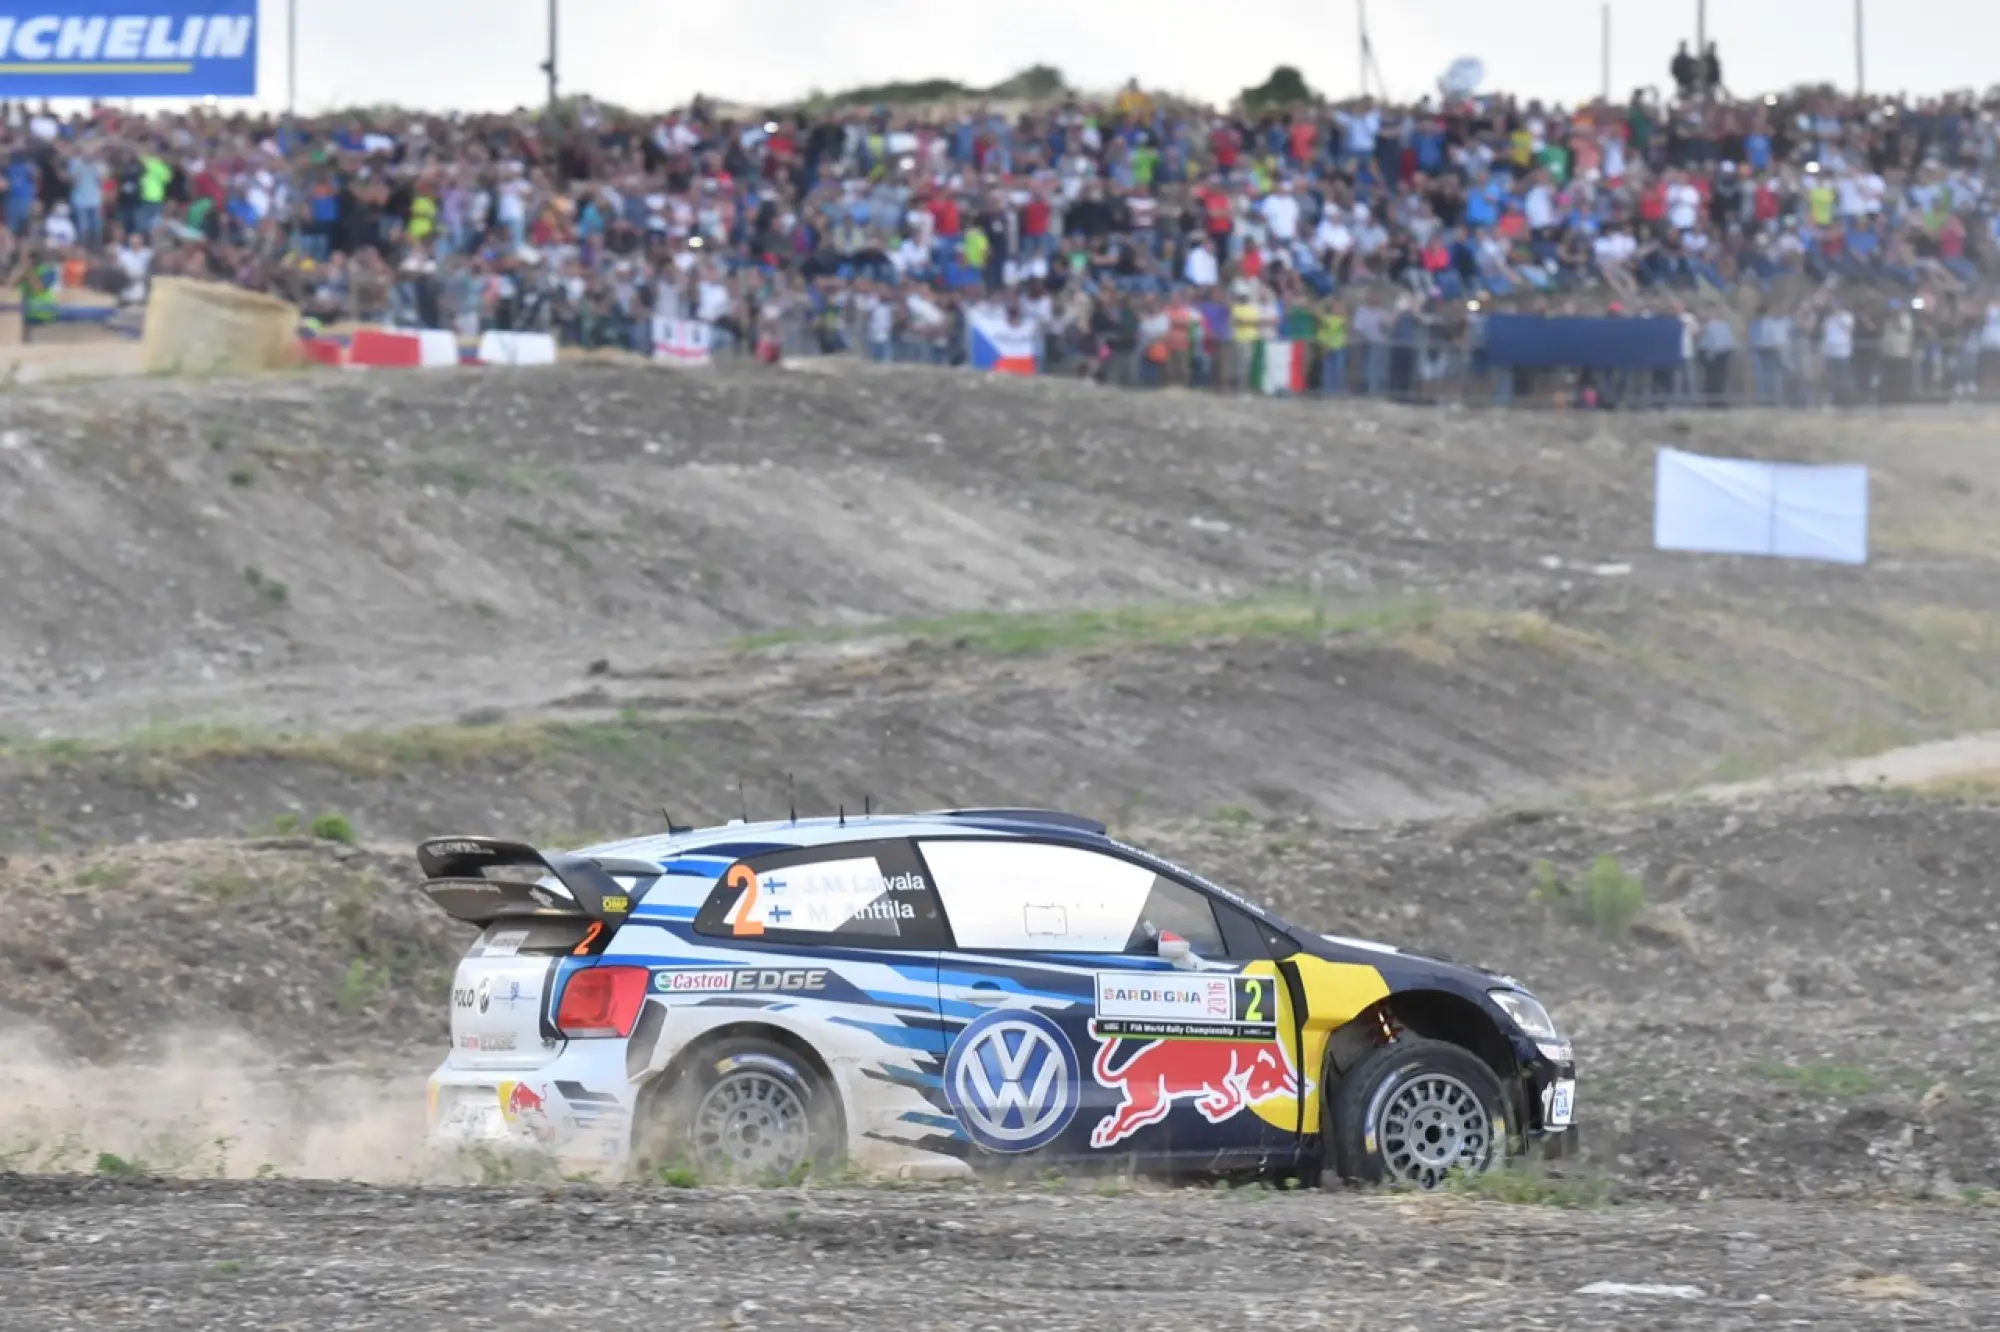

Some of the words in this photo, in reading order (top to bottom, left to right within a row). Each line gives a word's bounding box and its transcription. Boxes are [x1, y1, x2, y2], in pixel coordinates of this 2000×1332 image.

[603, 898, 628, 910] OMP
[727, 864, 765, 935] 2
[844, 900, 915, 921] Anttila
[572, 920, 605, 955] 2
[673, 973, 730, 989] Castrol
[734, 970, 829, 991] EDGE
[1103, 988, 1202, 1004] SARDEGNA
[1207, 981, 1227, 1015] 2016
[1245, 979, 1263, 1021] 2
[1144, 1023, 1165, 1033] World
[1166, 1024, 1184, 1035] Rally
[1185, 1023, 1234, 1037] Championship
